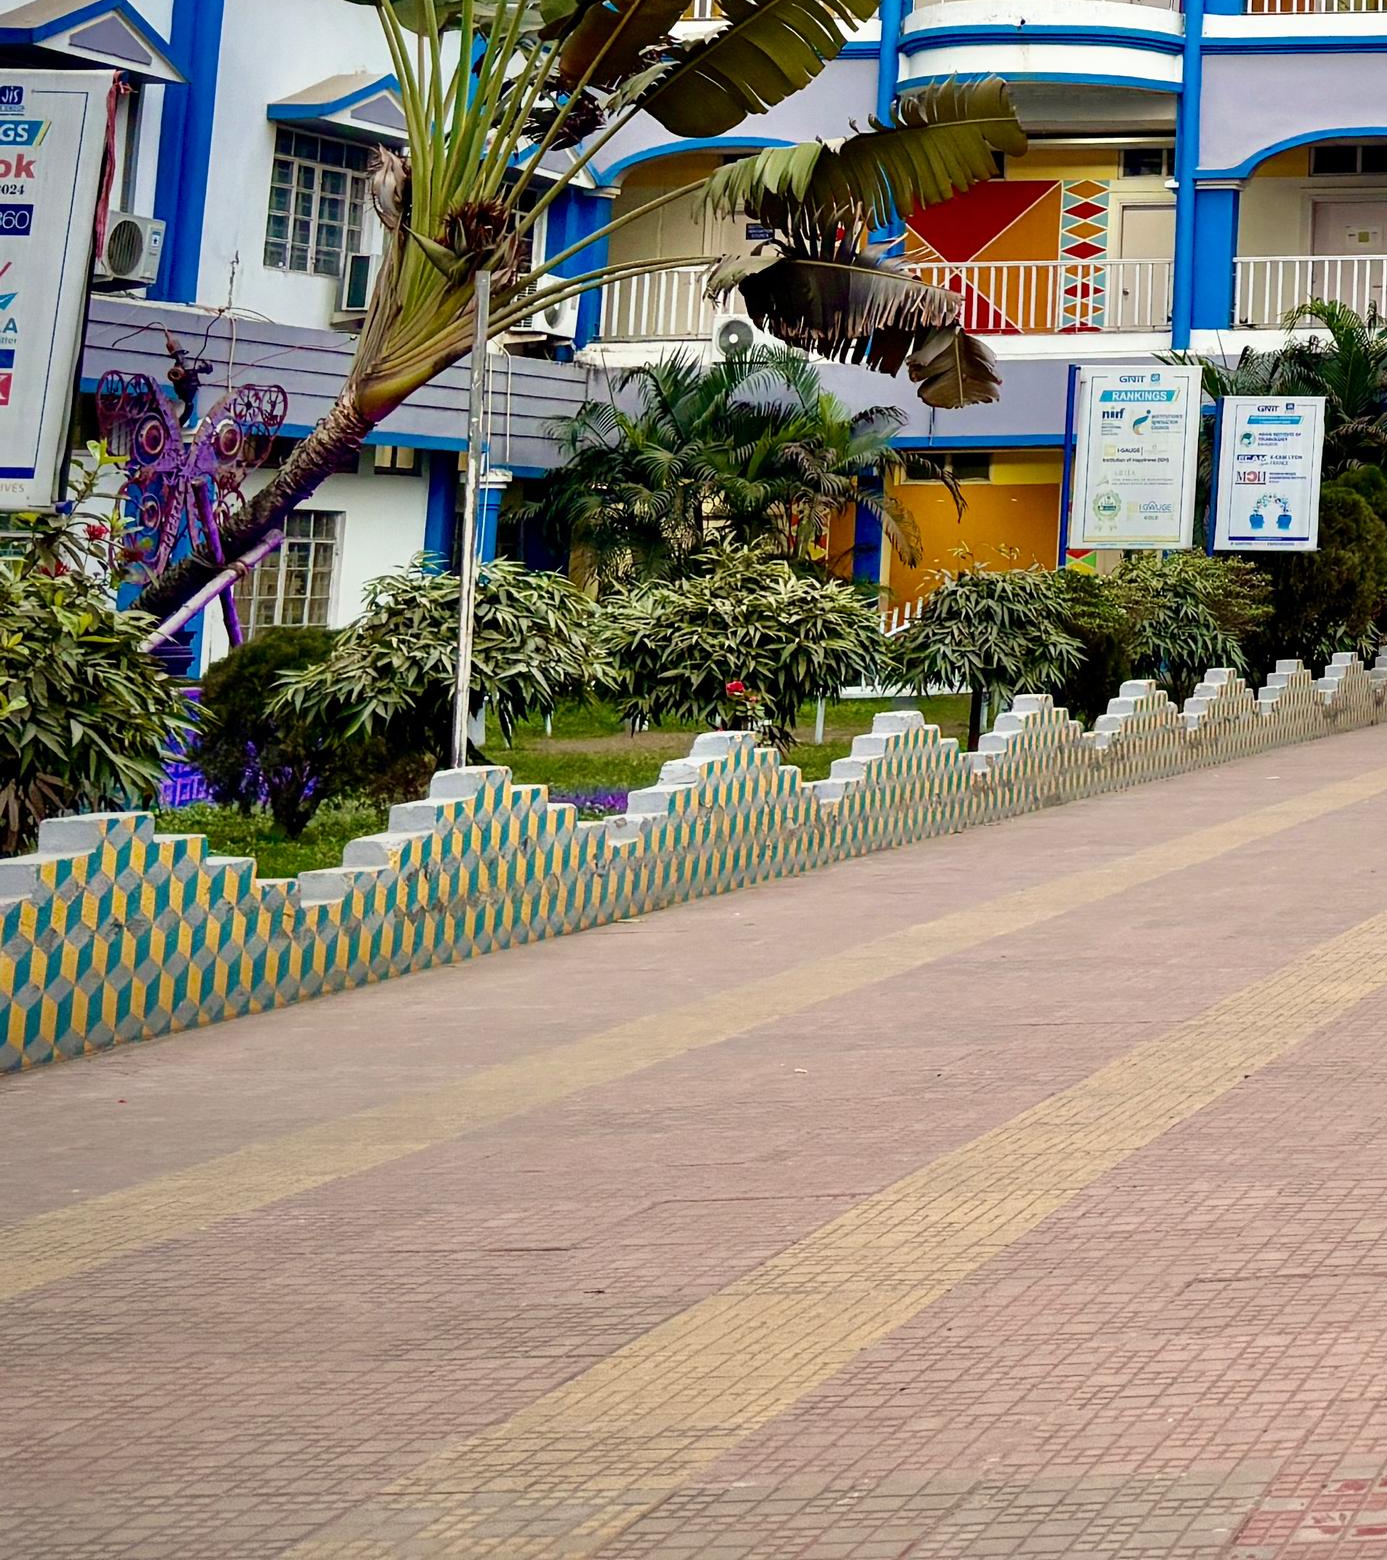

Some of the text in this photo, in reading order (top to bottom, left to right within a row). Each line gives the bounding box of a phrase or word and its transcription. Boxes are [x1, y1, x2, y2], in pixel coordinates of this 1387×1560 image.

[0, 183, 25, 195] 024
[0, 210, 30, 229] 60
[1119, 375, 1146, 383] GNIT
[1112, 391, 1167, 401] RANKINGS
[1102, 407, 1126, 419] nirf
